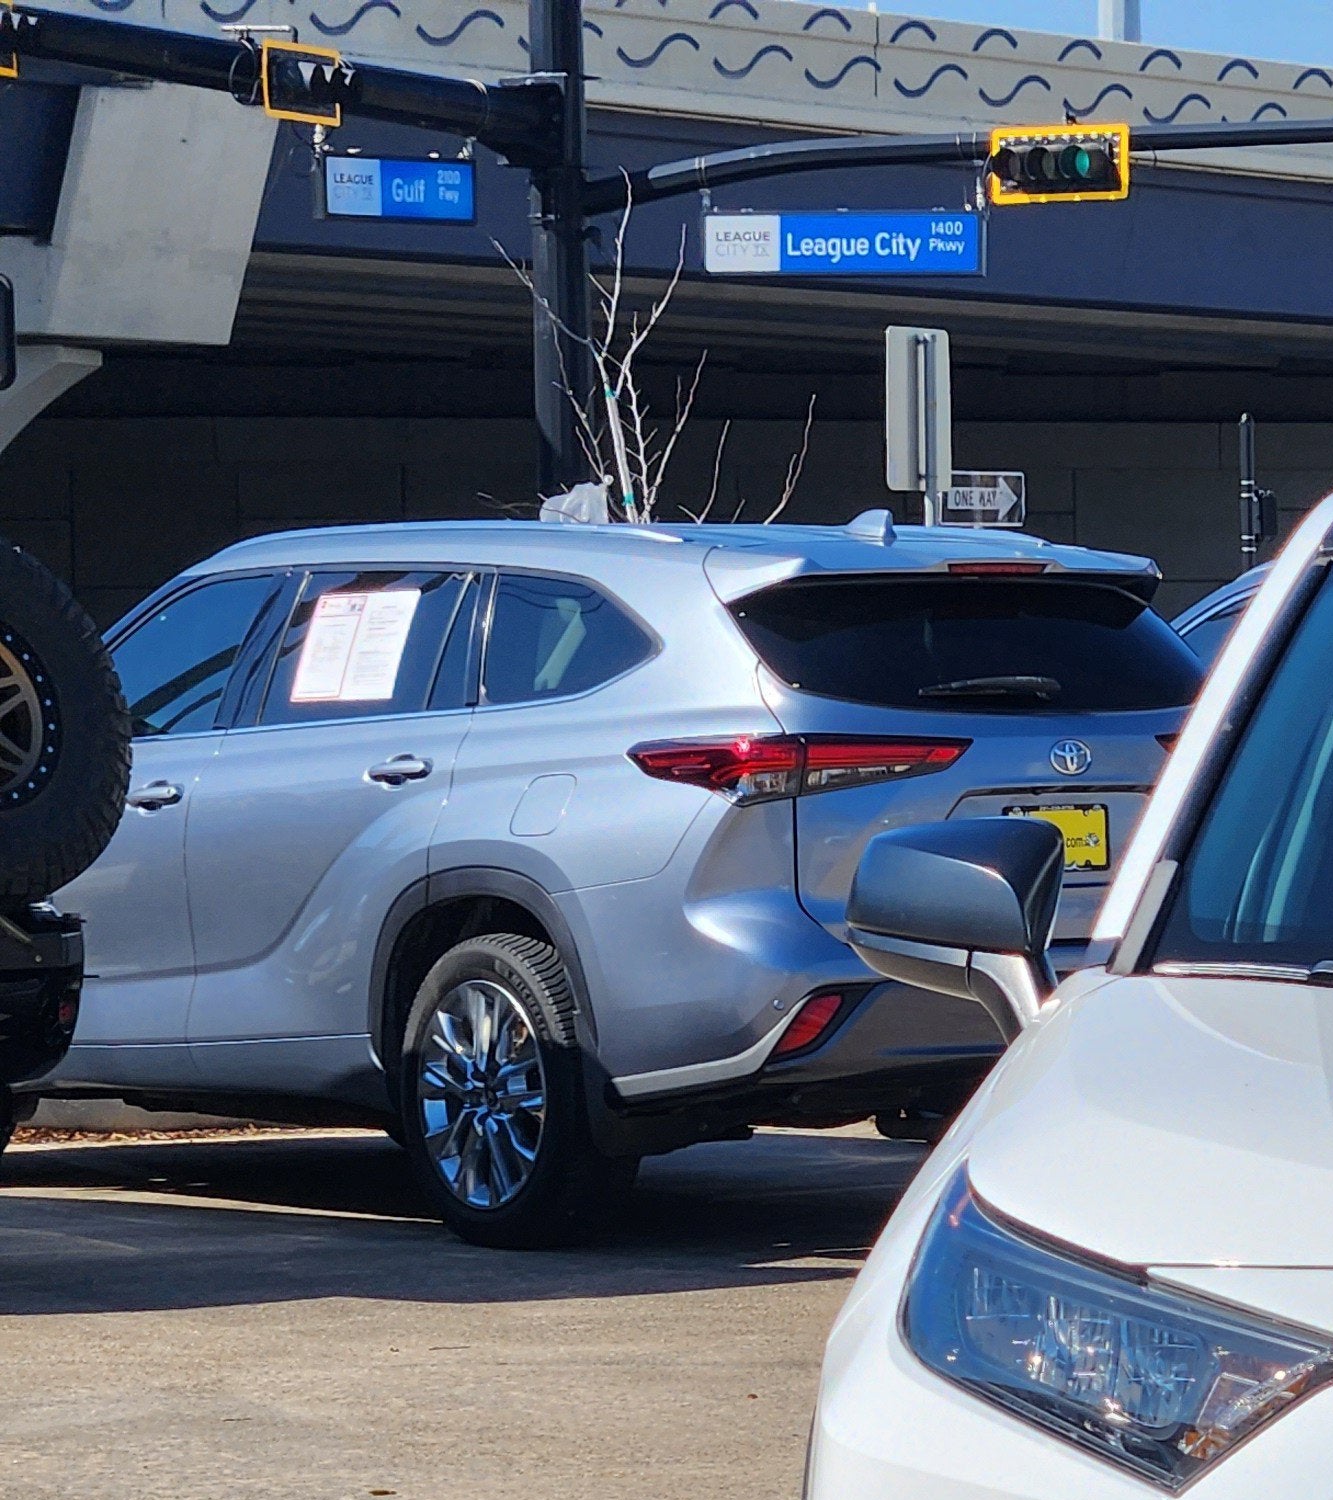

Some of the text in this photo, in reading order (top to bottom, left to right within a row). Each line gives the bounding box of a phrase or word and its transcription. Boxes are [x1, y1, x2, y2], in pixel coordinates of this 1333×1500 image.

[333, 173, 374, 185] LEAGUE
[392, 178, 425, 203] Gulf
[438, 187, 460, 204] Fwy
[715, 231, 770, 242] LEAGUE
[931, 221, 963, 235] 1400
[716, 244, 747, 256] CITY
[787, 232, 921, 263] League City
[929, 238, 965, 255] Pkwy
[954, 490, 997, 507] ONE WAY
